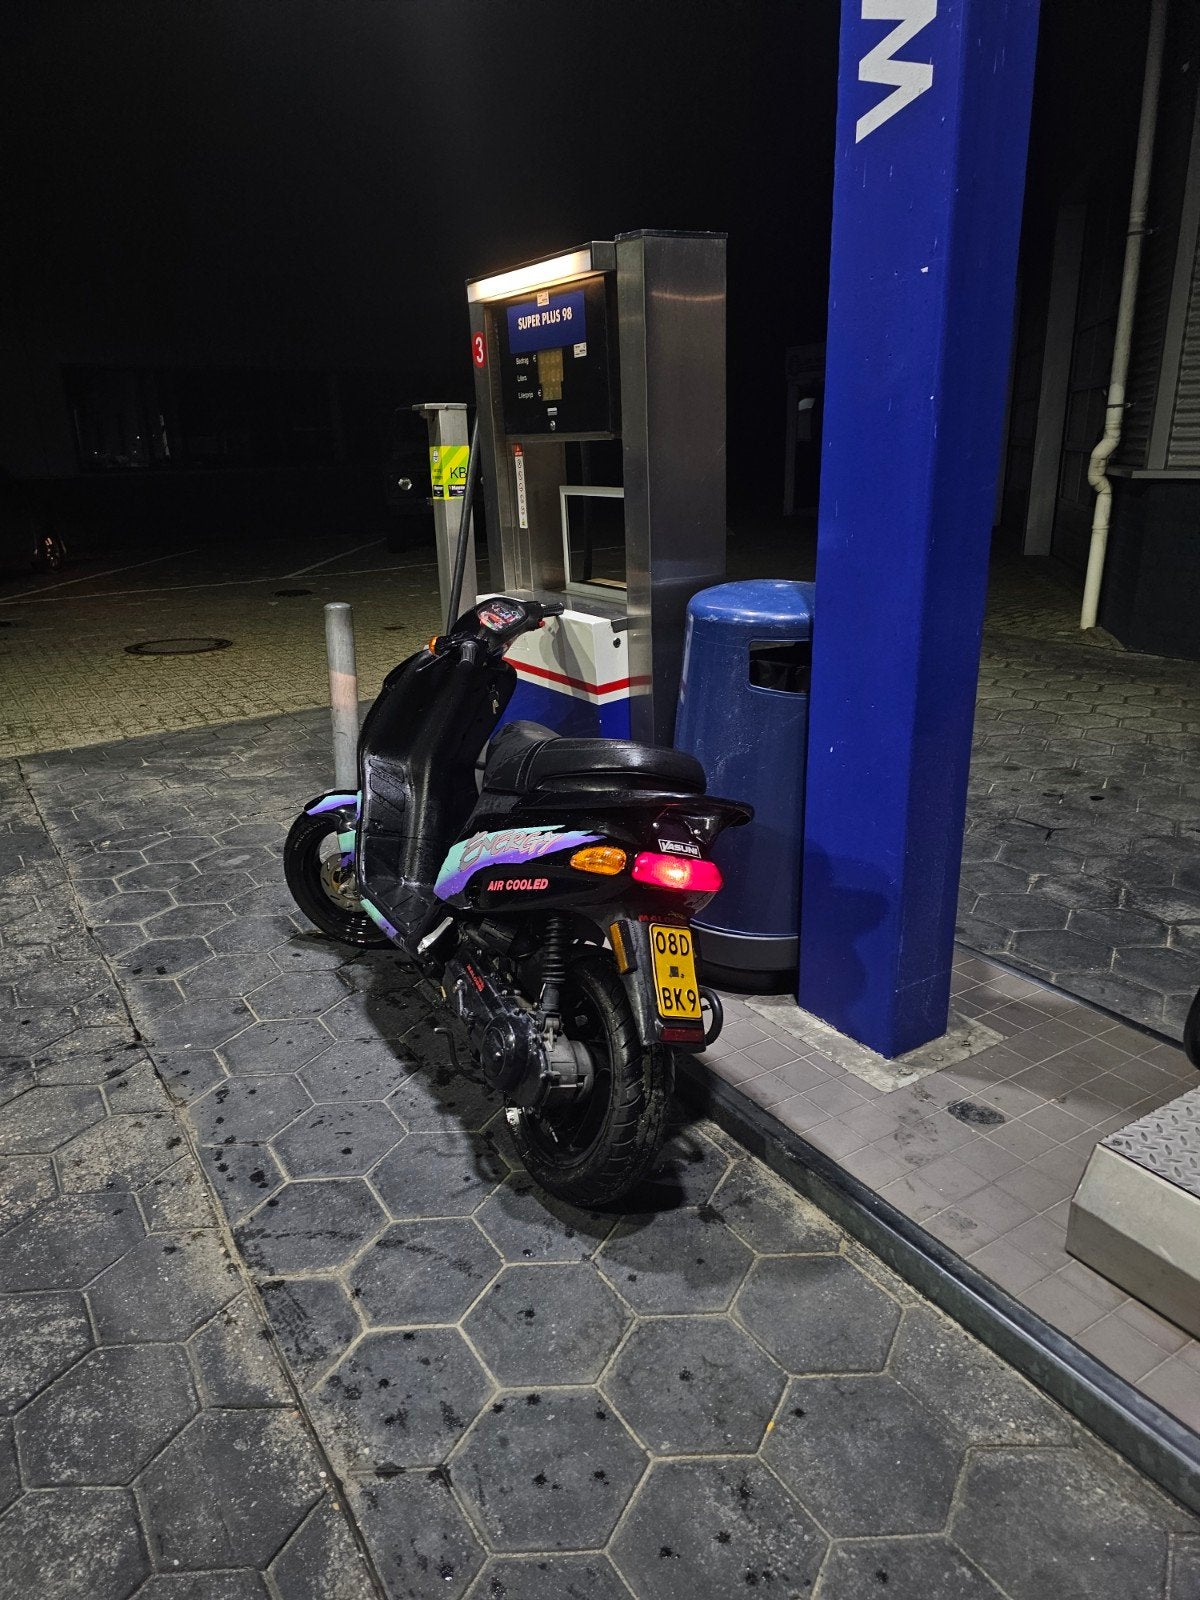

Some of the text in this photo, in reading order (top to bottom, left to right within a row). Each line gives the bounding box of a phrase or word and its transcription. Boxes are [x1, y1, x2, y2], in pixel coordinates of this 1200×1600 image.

[517, 307, 573, 331] SUPER PLUS 98
[475, 336, 484, 363] 3
[458, 829, 563, 873] ENERGY
[487, 878, 549, 892] AIR COOLED
[662, 986, 697, 1012] BK9
